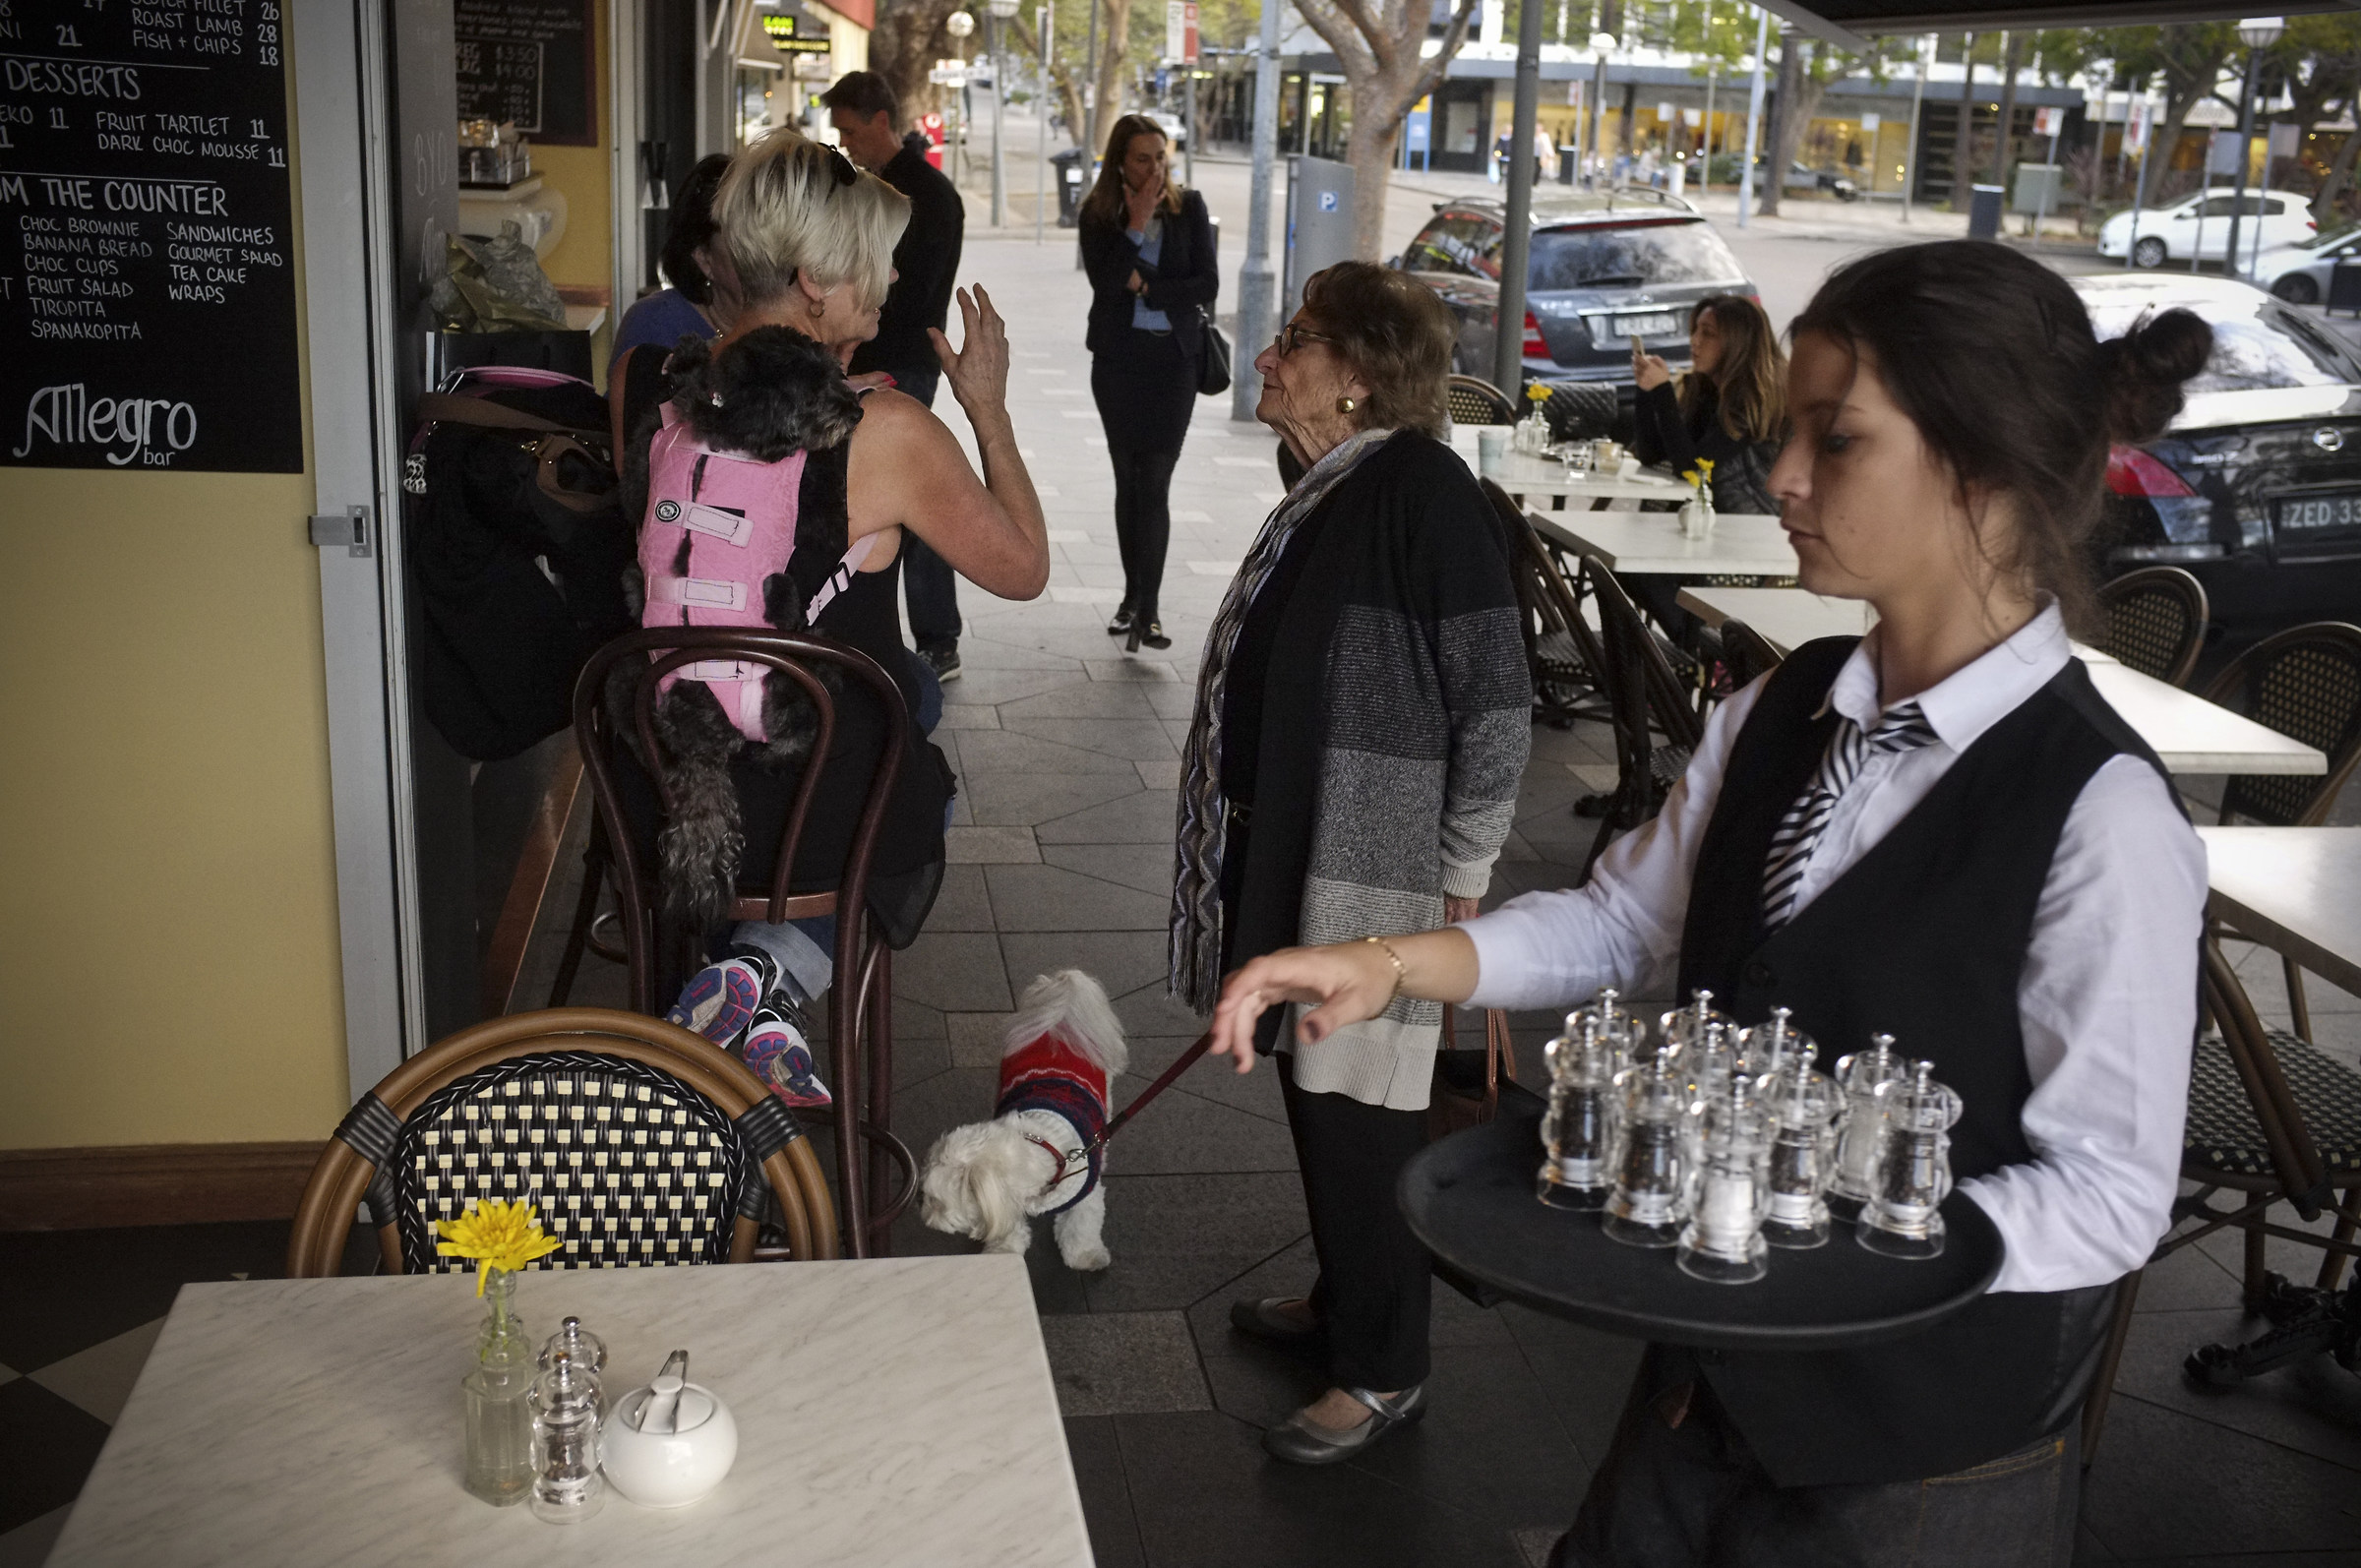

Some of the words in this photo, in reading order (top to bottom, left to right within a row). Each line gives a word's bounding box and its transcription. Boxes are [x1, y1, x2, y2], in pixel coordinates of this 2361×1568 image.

[195, 0, 245, 17] FILLET
[261, 2, 278, 20] 26
[56, 25, 83, 46] 21
[133, 7, 186, 29] ROAST
[197, 15, 242, 35] LAMB
[258, 24, 276, 42] 28
[134, 30, 171, 50] FISH
[195, 36, 241, 54] CHIPS
[261, 46, 278, 66] 18
[6, 59, 141, 99] DESSERTS
[96, 111, 146, 131] FRUIT
[155, 114, 229, 136] TARTLET
[251, 119, 271, 139] 11
[98, 134, 143, 151] DARK
[153, 136, 194, 154] CHOC
[202, 143, 259, 159] MOUSSE
[268, 147, 285, 167] 11
[40, 178, 94, 210] THE
[105, 181, 228, 216] COUNTER
[1320, 192, 1336, 211] P
[21, 215, 61, 231] CHOC
[69, 217, 139, 236] BROWNIE
[167, 222, 273, 245] SANDWICHES
[24, 233, 92, 255] BANANA
[99, 239, 151, 257] BREAD
[169, 244, 232, 264] GOURMET
[241, 249, 282, 267] SALAD
[25, 254, 67, 272] CHOC
[76, 259, 118, 276] CUPS
[170, 265, 199, 280] TEA
[207, 268, 246, 283] CAKE
[28, 275, 75, 294] FRUIT
[81, 278, 133, 297] SALAD
[169, 285, 224, 303] WRAPS
[30, 297, 105, 317] TIROPITA
[31, 320, 142, 339] SPANAKOPITA
[14, 384, 197, 465] Allegro
[144, 447, 175, 465] bar
